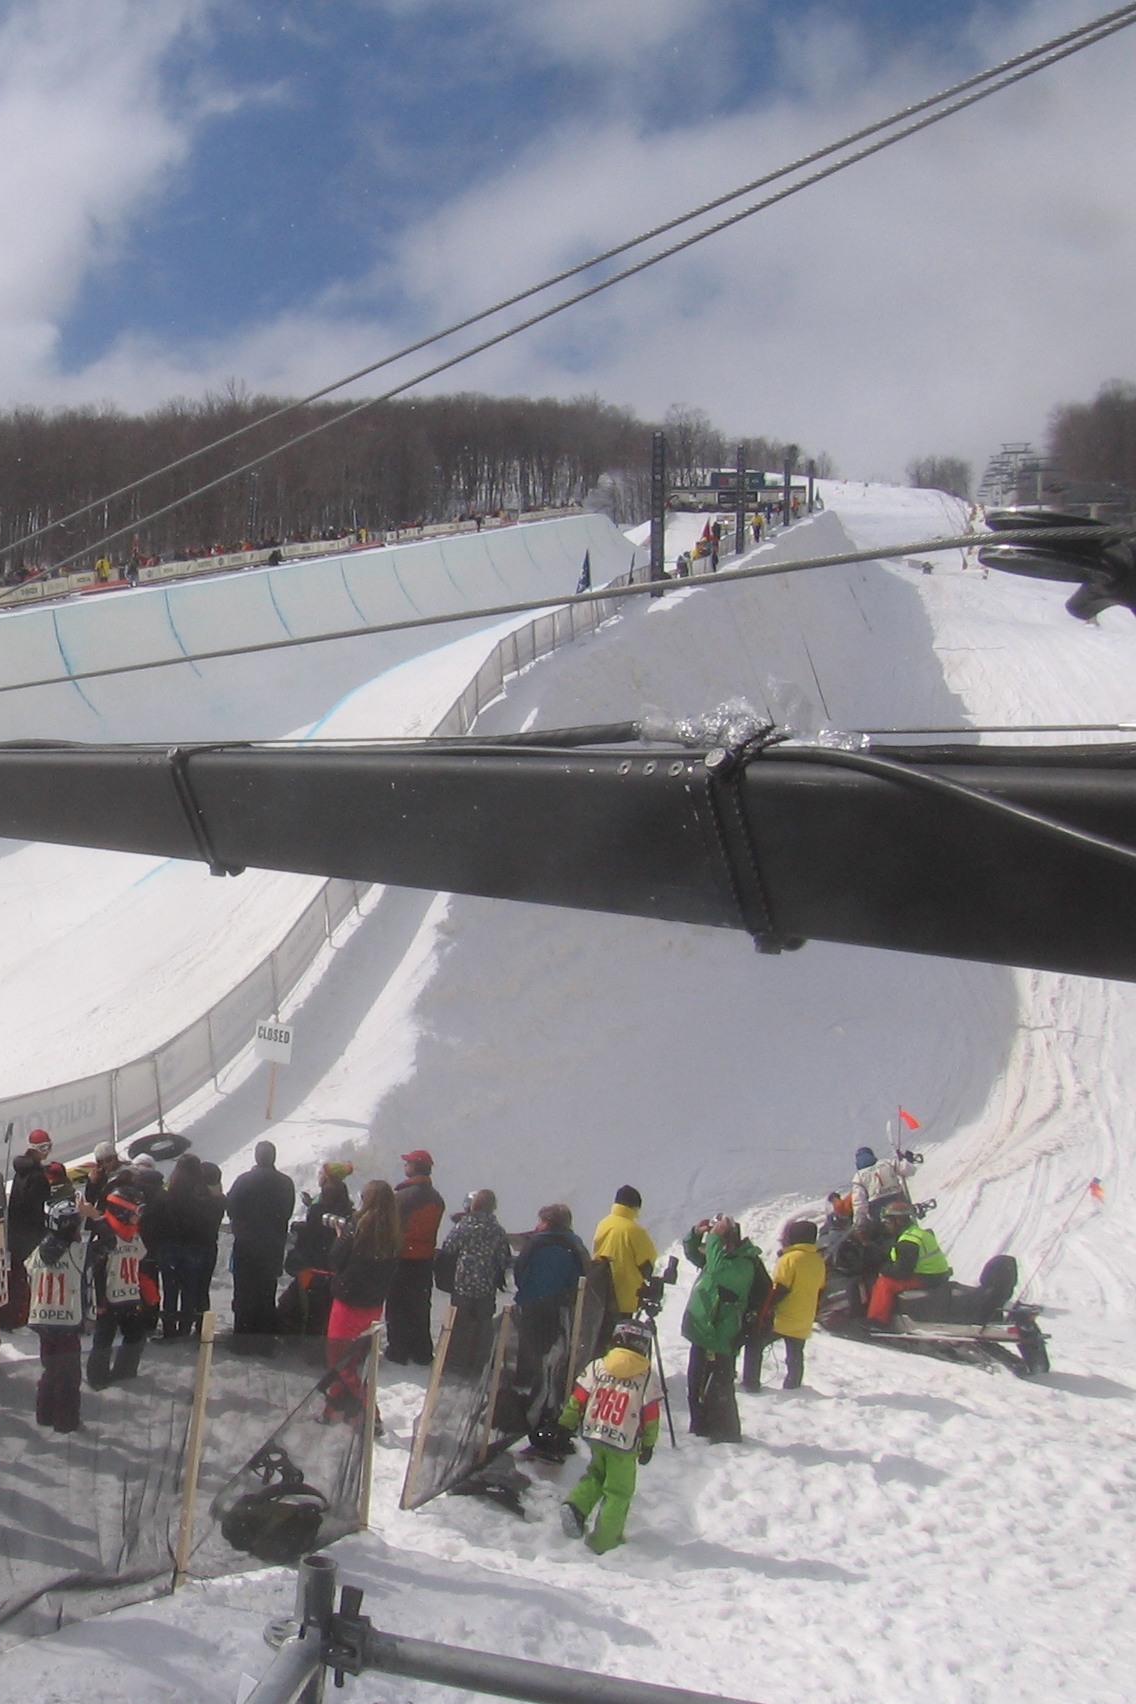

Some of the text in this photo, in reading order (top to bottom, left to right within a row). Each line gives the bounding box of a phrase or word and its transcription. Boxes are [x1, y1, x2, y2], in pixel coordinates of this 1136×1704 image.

[258, 1026, 290, 1044] CLOSED
[38, 1308, 74, 1321] OPEN
[591, 1387, 630, 1427] 369
